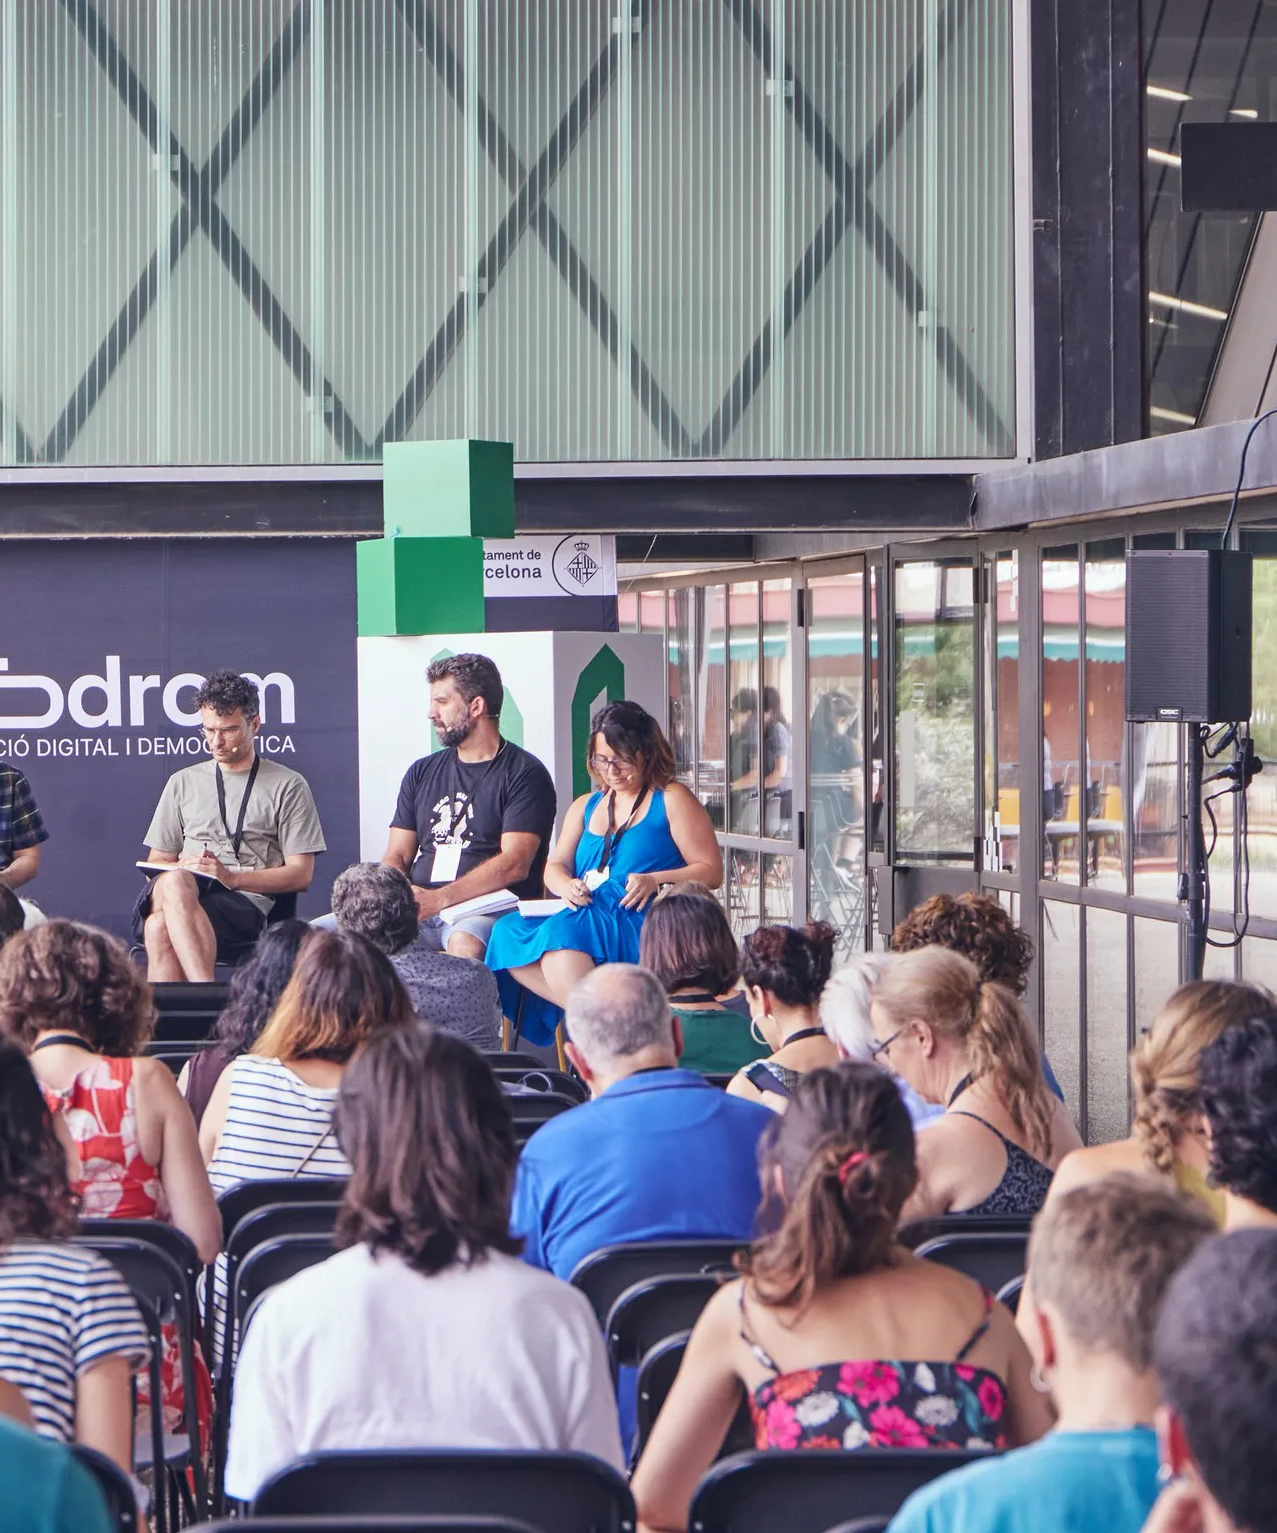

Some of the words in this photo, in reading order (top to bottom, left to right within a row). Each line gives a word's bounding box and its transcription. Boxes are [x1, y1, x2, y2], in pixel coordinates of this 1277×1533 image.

[483, 550, 524, 560] tament
[527, 549, 541, 560] de
[485, 564, 542, 579] celona
[36, 737, 119, 757] DIGITAL
[126, 737, 131, 756] I
[138, 735, 296, 756] DEMOCICA
